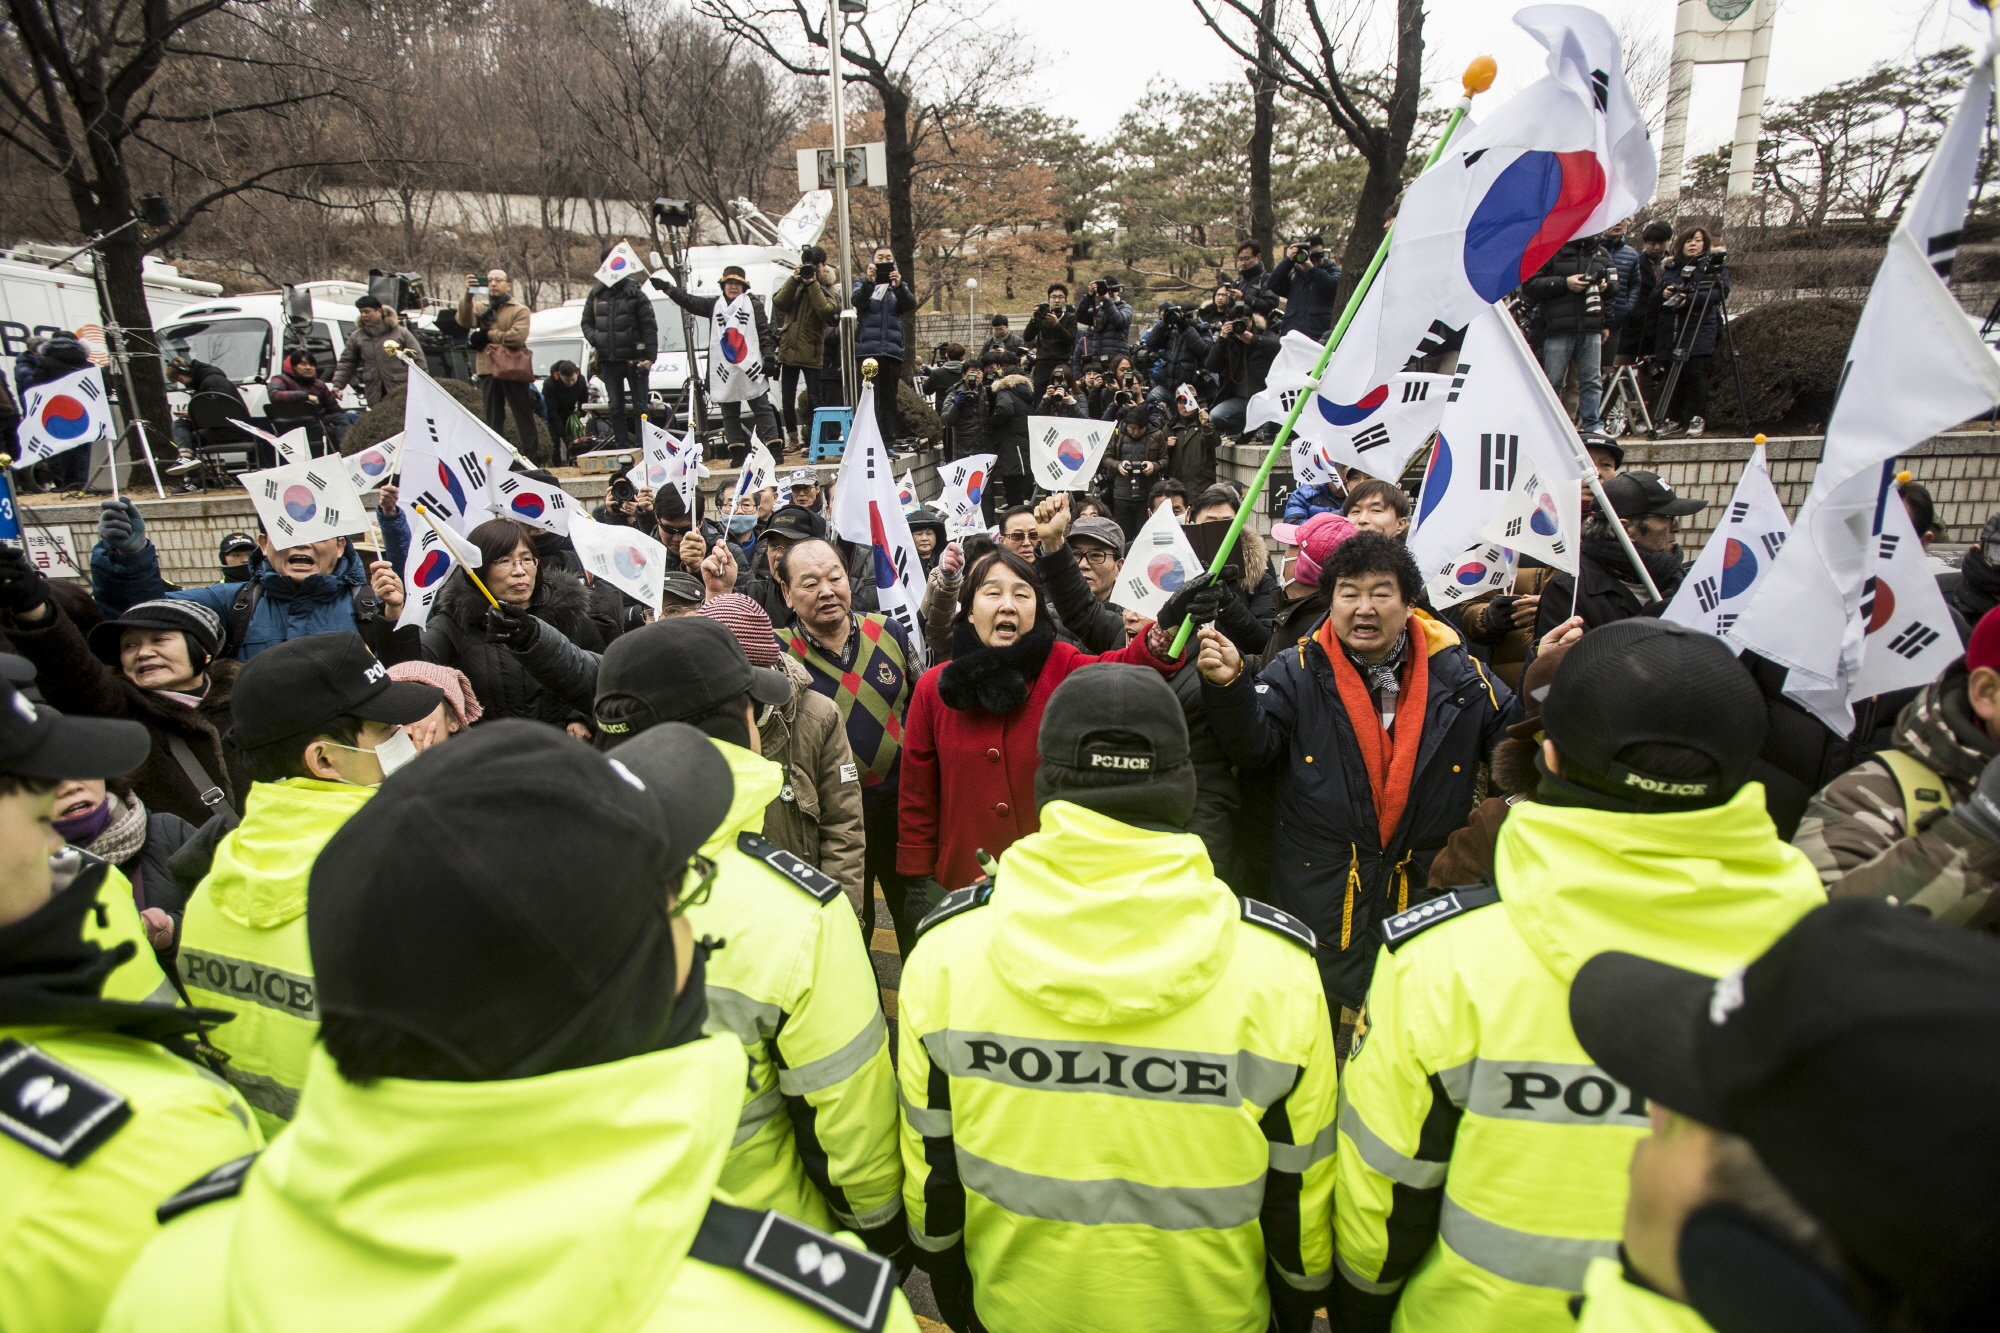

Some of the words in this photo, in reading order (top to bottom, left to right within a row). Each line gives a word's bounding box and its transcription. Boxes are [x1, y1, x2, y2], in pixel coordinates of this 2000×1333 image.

[1091, 754, 1150, 770] POLICE
[1624, 773, 1708, 795] POLICE
[183, 953, 314, 1012] POLICE
[964, 1040, 1228, 1097] POLICE
